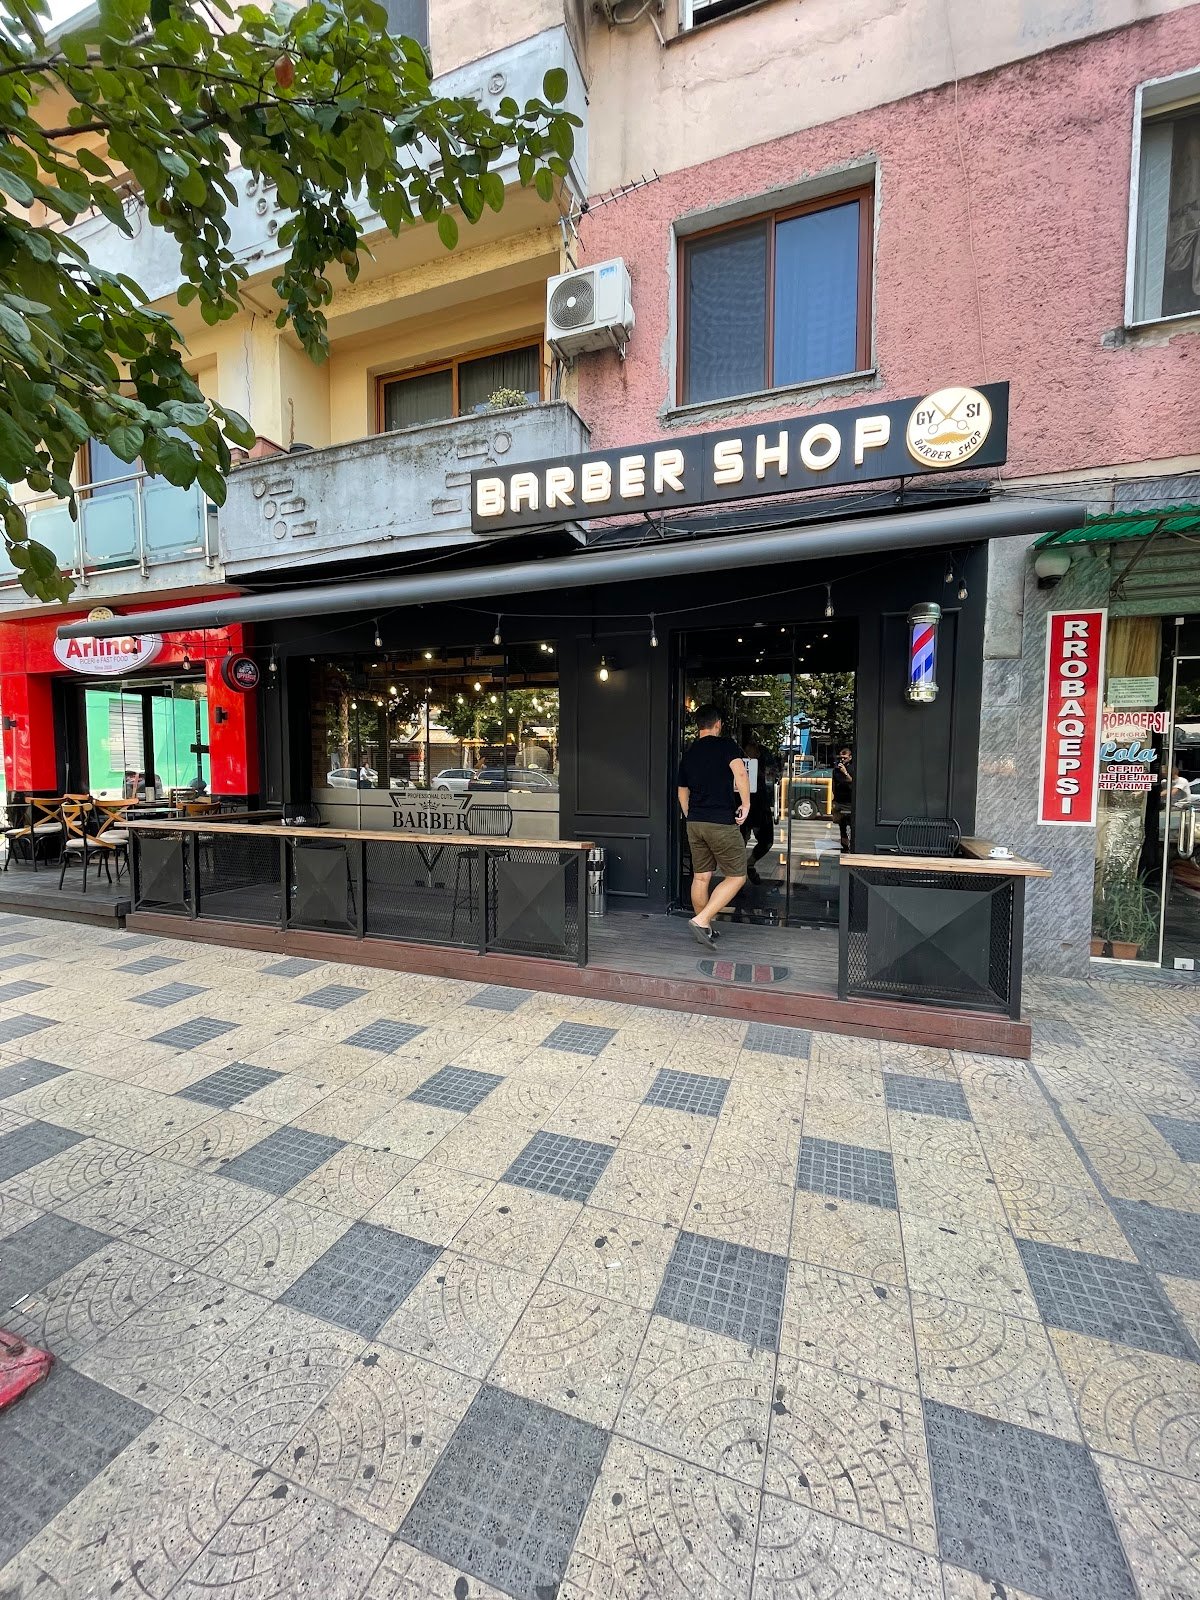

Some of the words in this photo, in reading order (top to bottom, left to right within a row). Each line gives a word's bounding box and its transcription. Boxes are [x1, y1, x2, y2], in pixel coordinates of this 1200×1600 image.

[916, 410, 936, 426] GY
[966, 402, 981, 418] SI
[914, 438, 952, 460] BARBER
[958, 430, 982, 456] SHOP
[476, 449, 685, 517] BARBER
[713, 415, 891, 485] SHOP
[1056, 620, 1089, 814] RROBAQEPSI
[1100, 741, 1158, 762] Lola
[1107, 765, 1144, 773] QEPIM
[1119, 774, 1157, 782] BEJME
[407, 792, 440, 800] PROFESSIONAL
[1098, 782, 1151, 790] RIPARIME
[392, 811, 470, 831] BARBER
